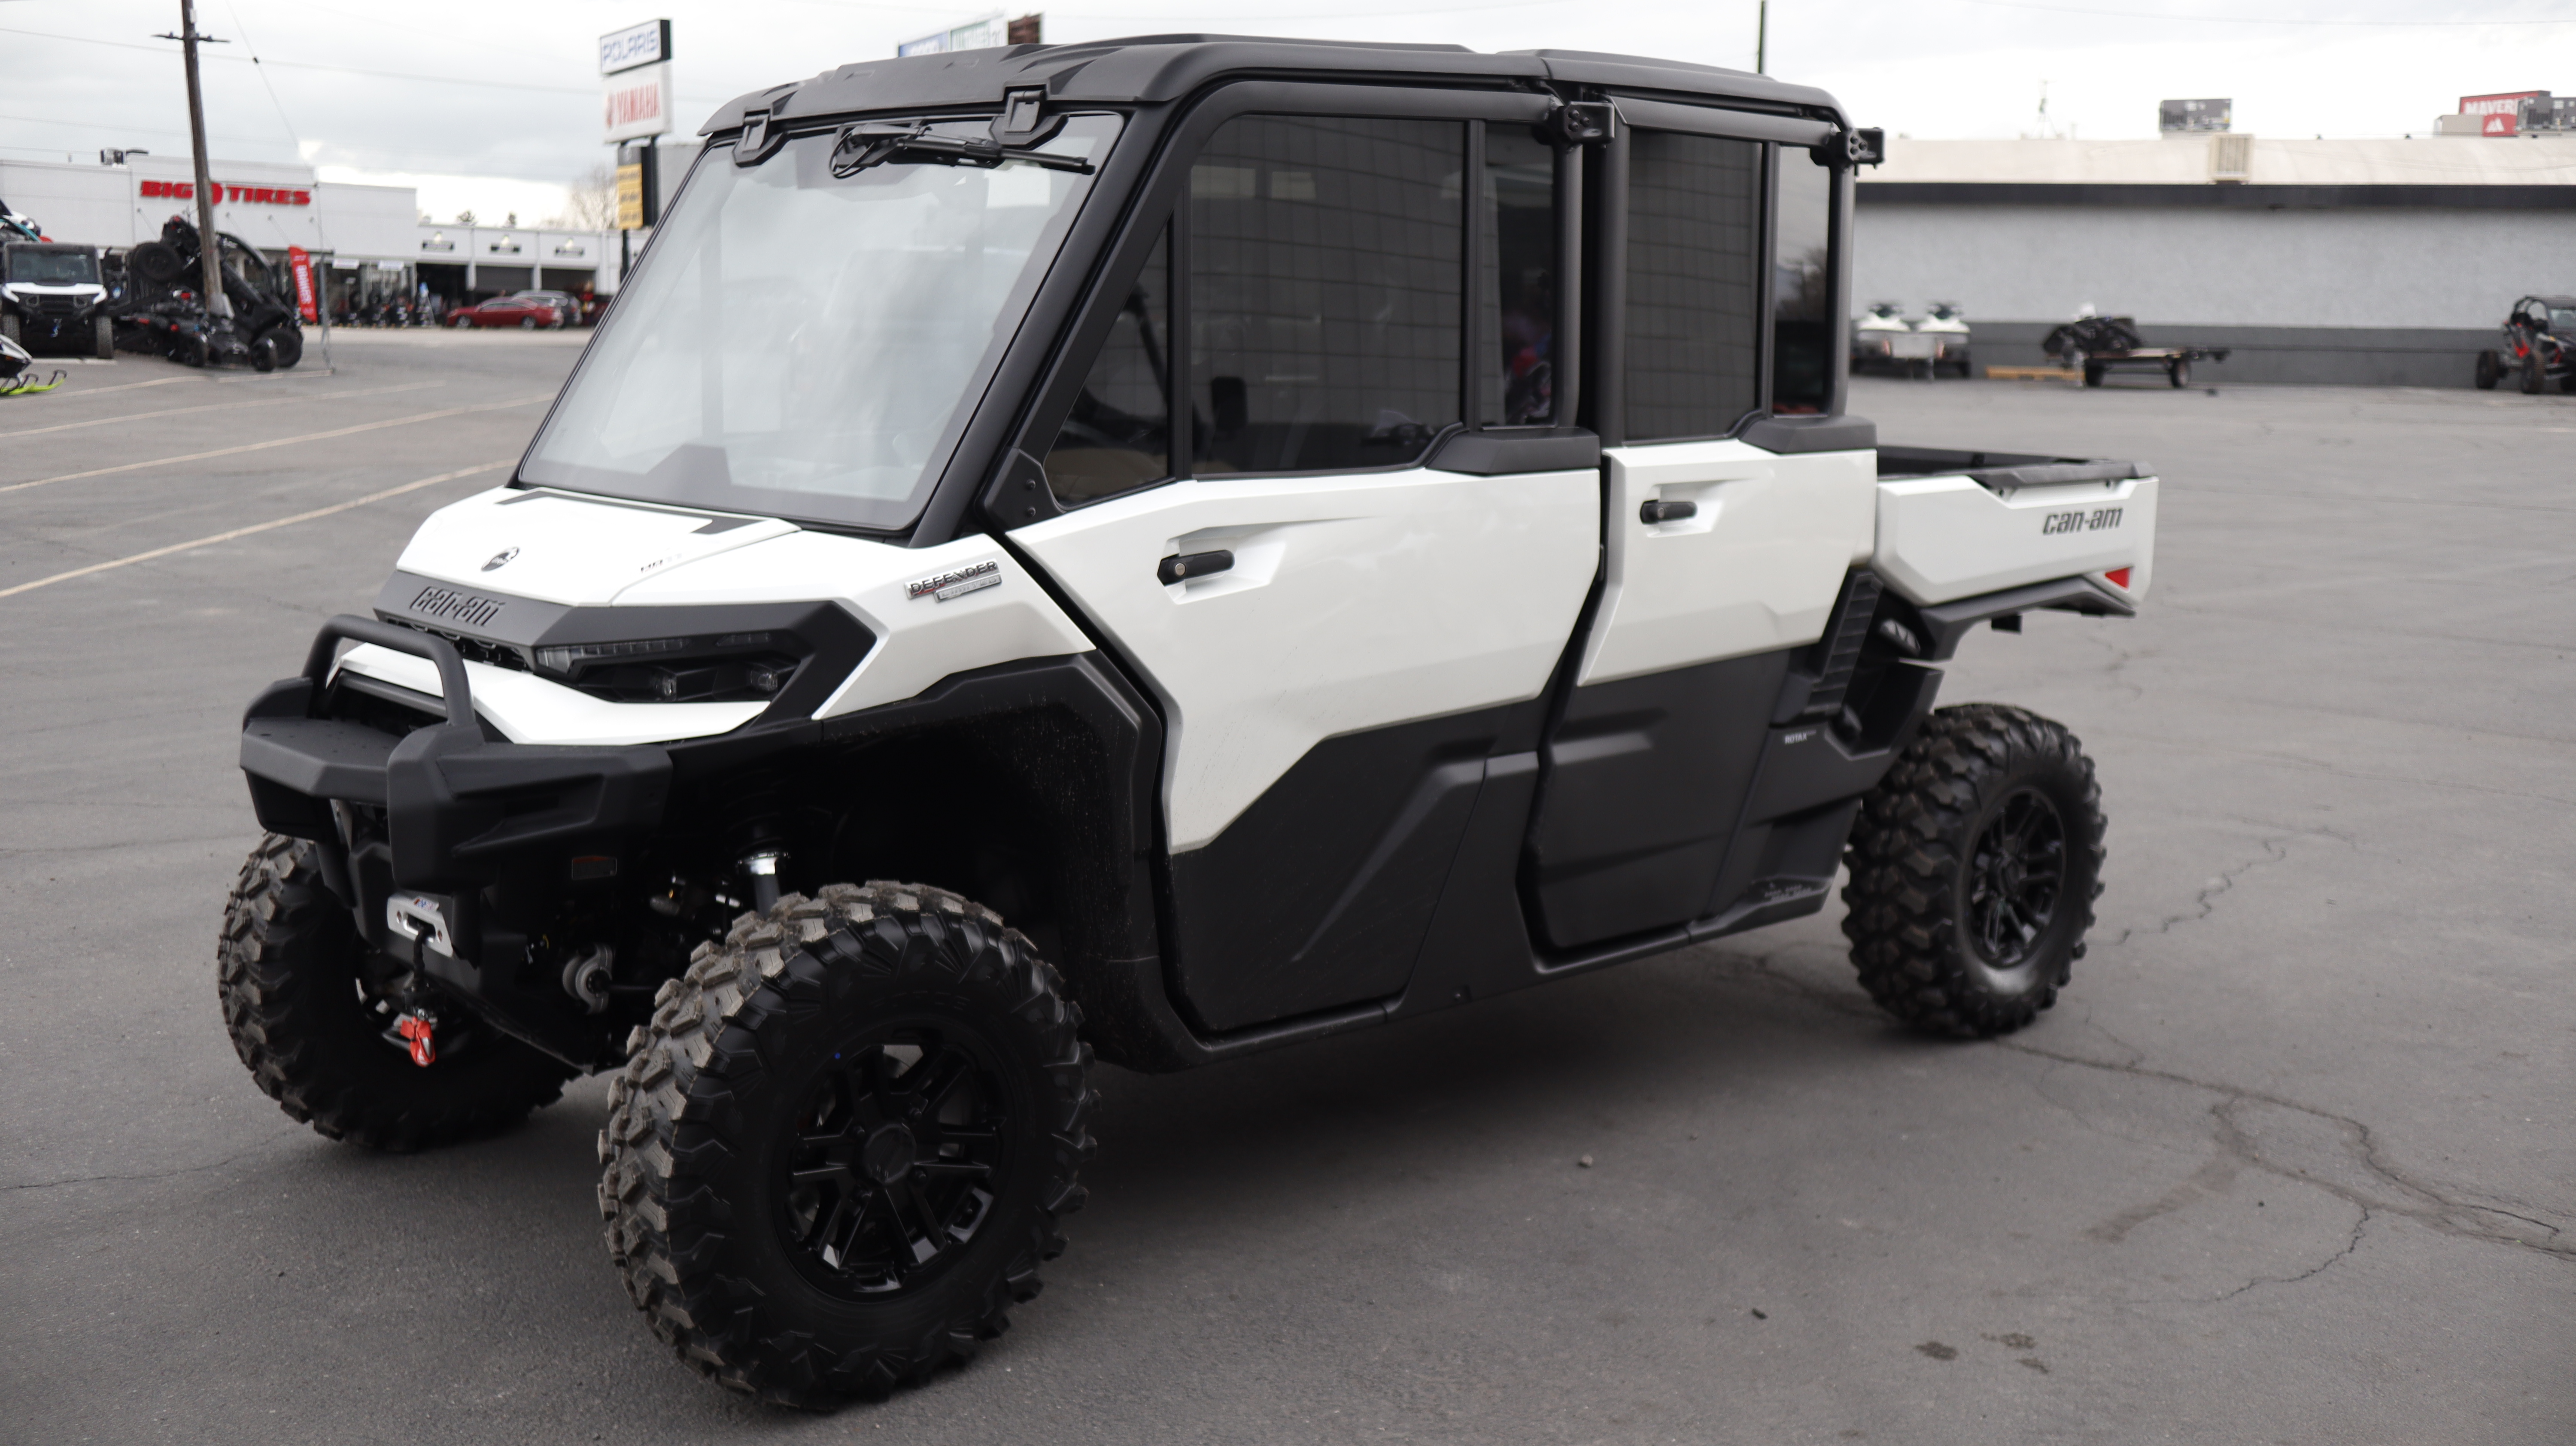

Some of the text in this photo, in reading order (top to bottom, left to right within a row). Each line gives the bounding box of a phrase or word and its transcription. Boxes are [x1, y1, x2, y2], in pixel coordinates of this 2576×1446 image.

[602, 30, 657, 62] POLARIS
[616, 82, 661, 124] YAMAHA
[2464, 99, 2518, 115] MAVER
[141, 180, 194, 199] BIG
[227, 185, 310, 205] TIRES
[2043, 507, 2123, 535] can-am
[910, 561, 998, 593] DEFENDER
[410, 586, 506, 626] can-am
[1785, 732, 1807, 744] ROTAX
